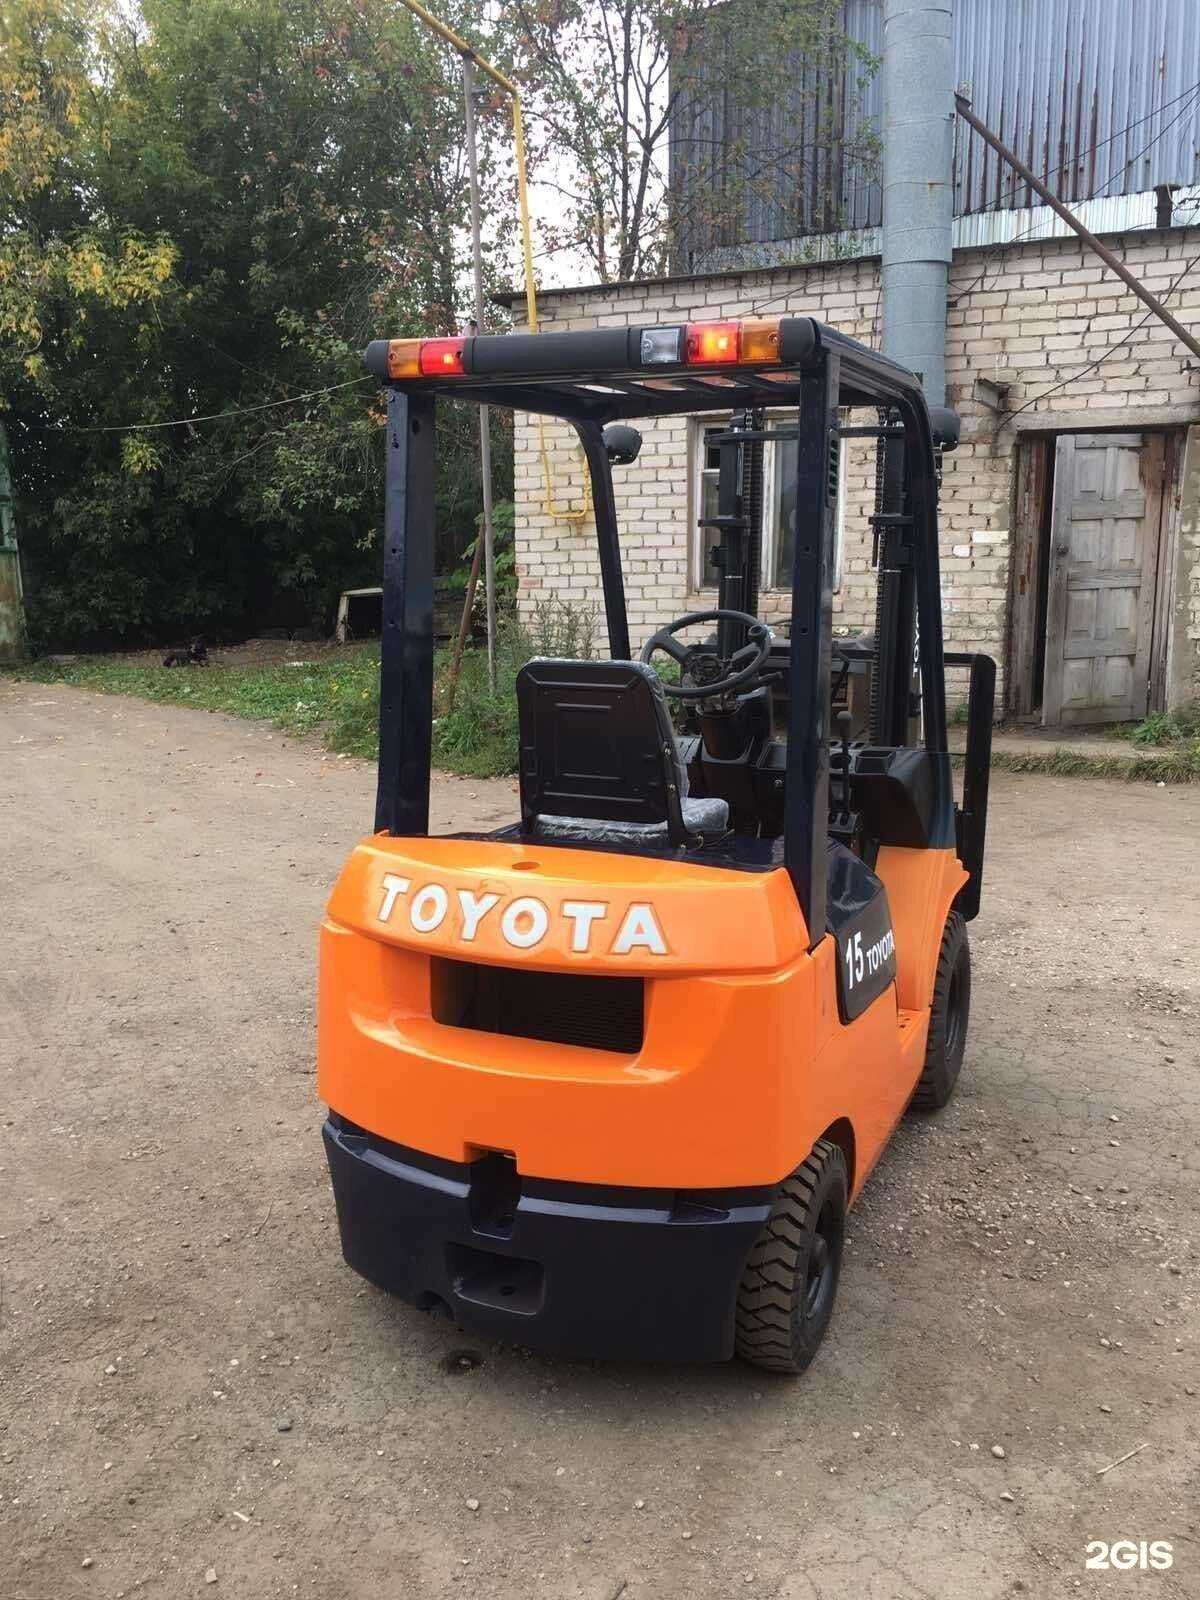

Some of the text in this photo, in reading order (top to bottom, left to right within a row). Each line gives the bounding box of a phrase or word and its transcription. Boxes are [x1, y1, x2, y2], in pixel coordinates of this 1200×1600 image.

[377, 873, 669, 954] TOYOTA
[846, 929, 895, 990] 15 TOYOTA
